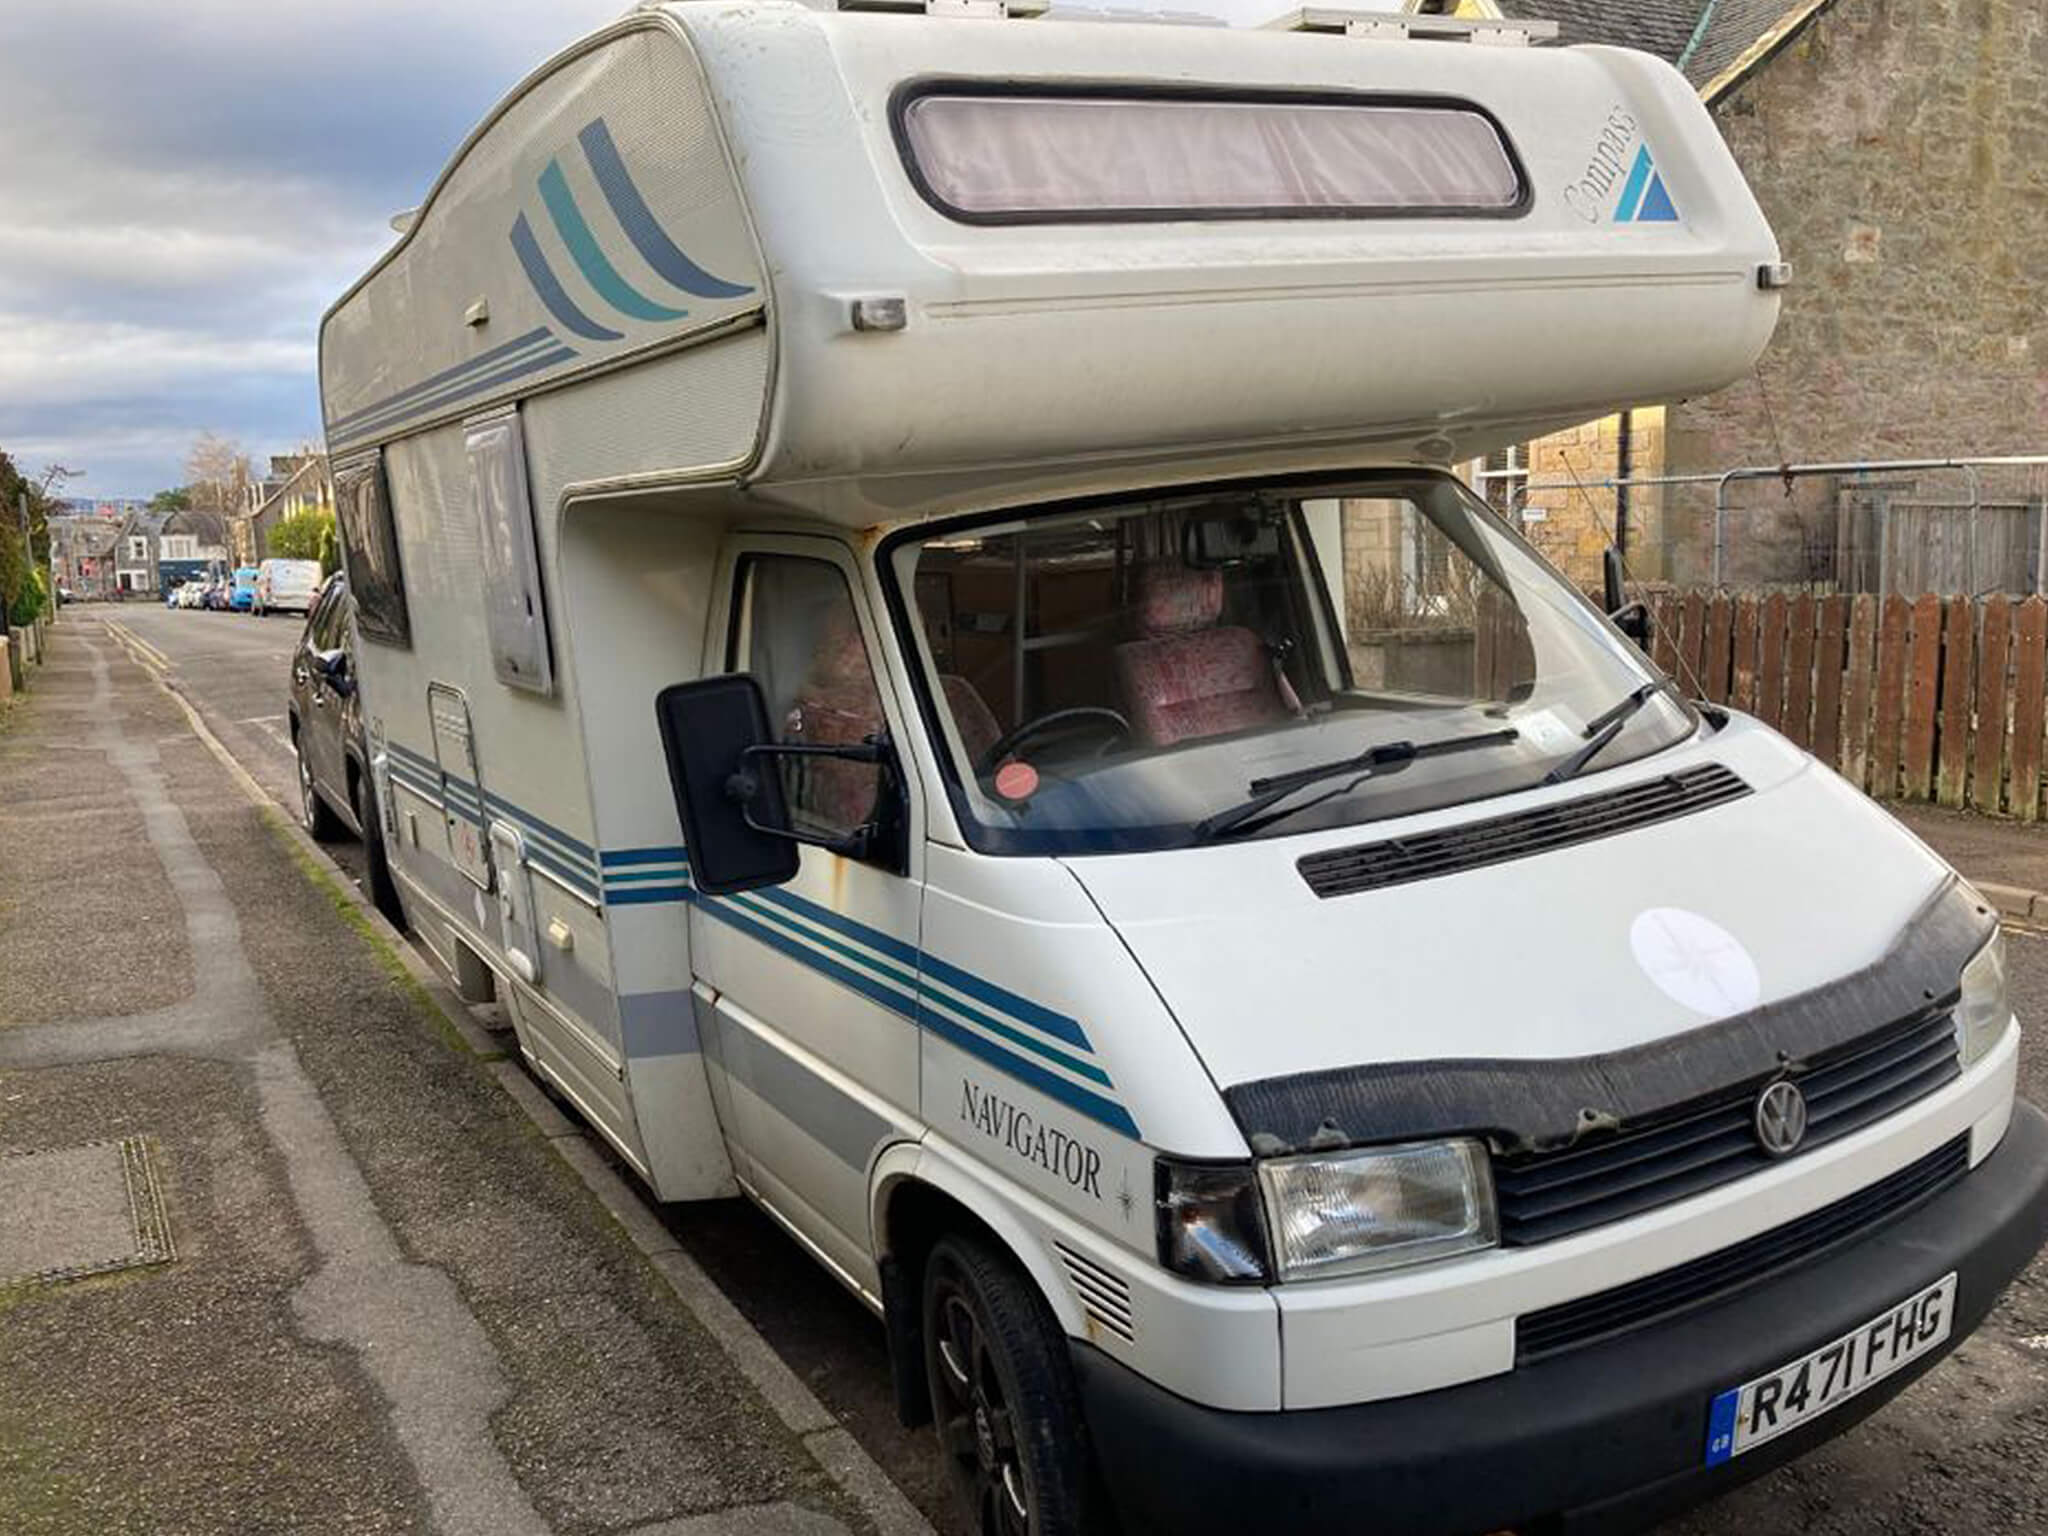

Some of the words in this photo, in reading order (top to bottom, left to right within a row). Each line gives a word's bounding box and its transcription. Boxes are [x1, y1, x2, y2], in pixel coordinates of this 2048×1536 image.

[1563, 104, 1637, 224] Compass
[960, 1079, 1102, 1199] NAVIGATOR
[1750, 1338, 1855, 1435] R471
[1865, 1289, 1942, 1376] FHG
